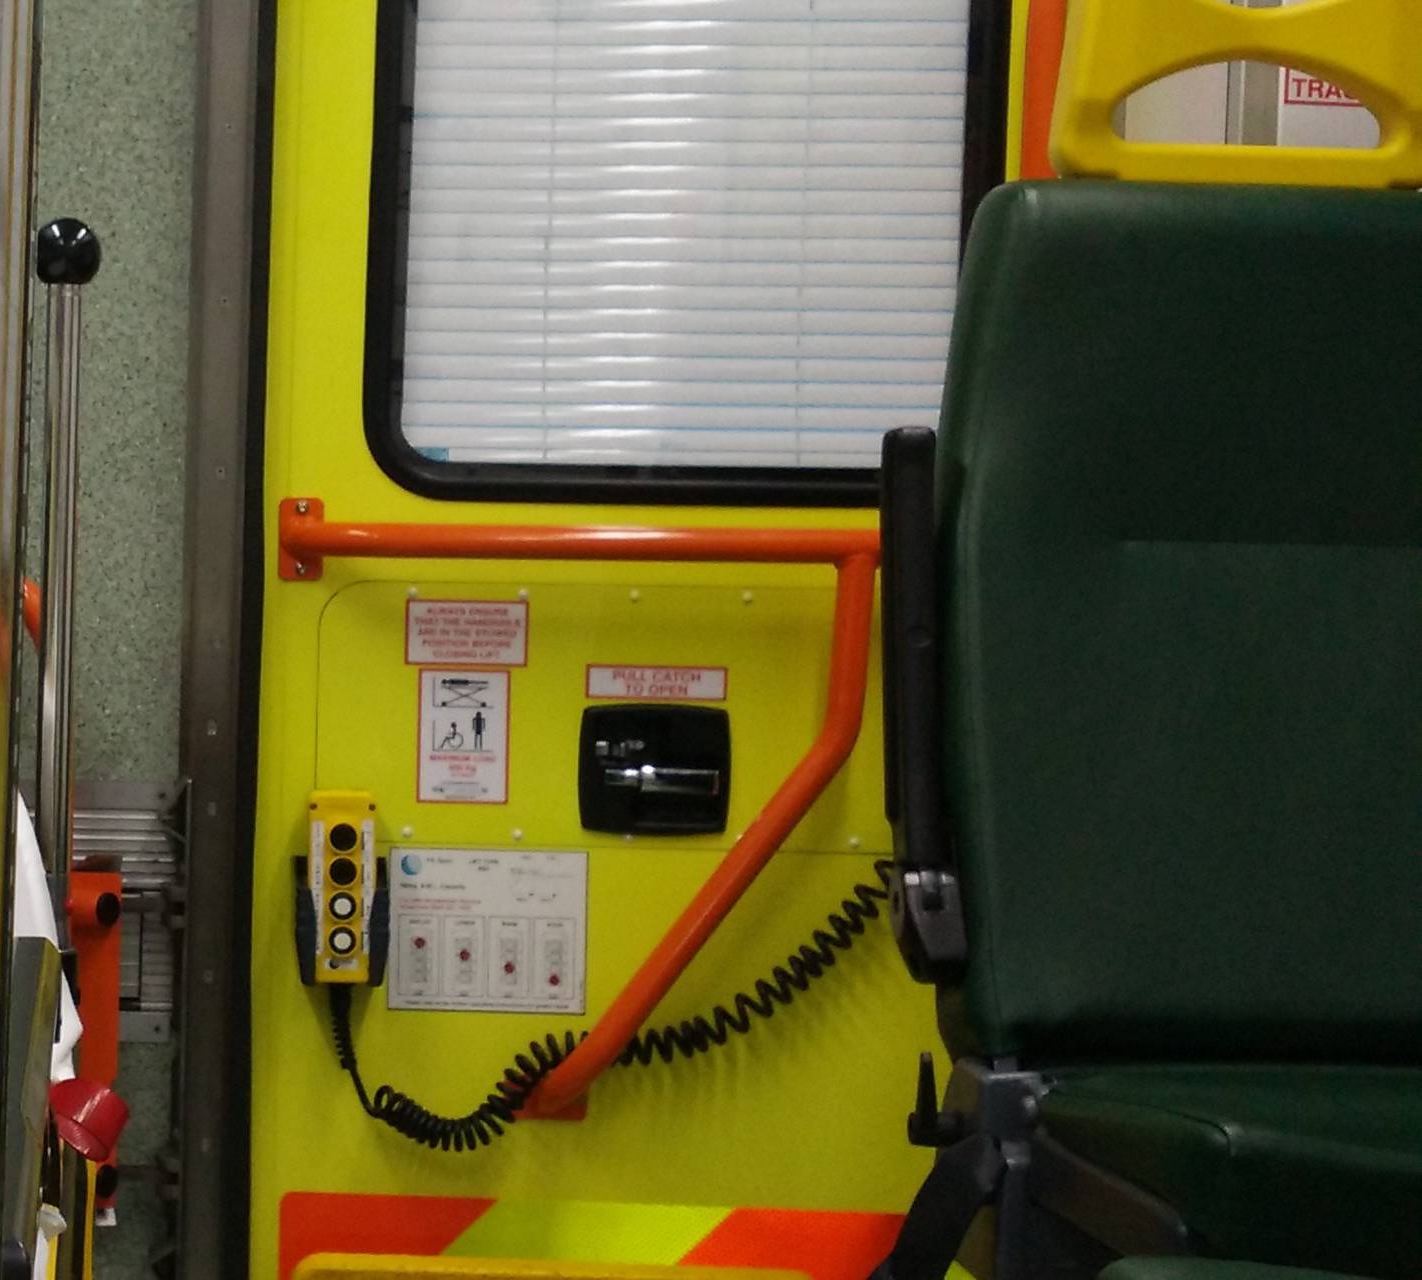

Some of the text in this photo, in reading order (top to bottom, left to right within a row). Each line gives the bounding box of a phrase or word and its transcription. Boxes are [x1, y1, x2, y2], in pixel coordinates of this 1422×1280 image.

[1292, 78, 1356, 99] TRA
[612, 669, 701, 683] PULL CATCH
[626, 684, 688, 697] TO OPEN
